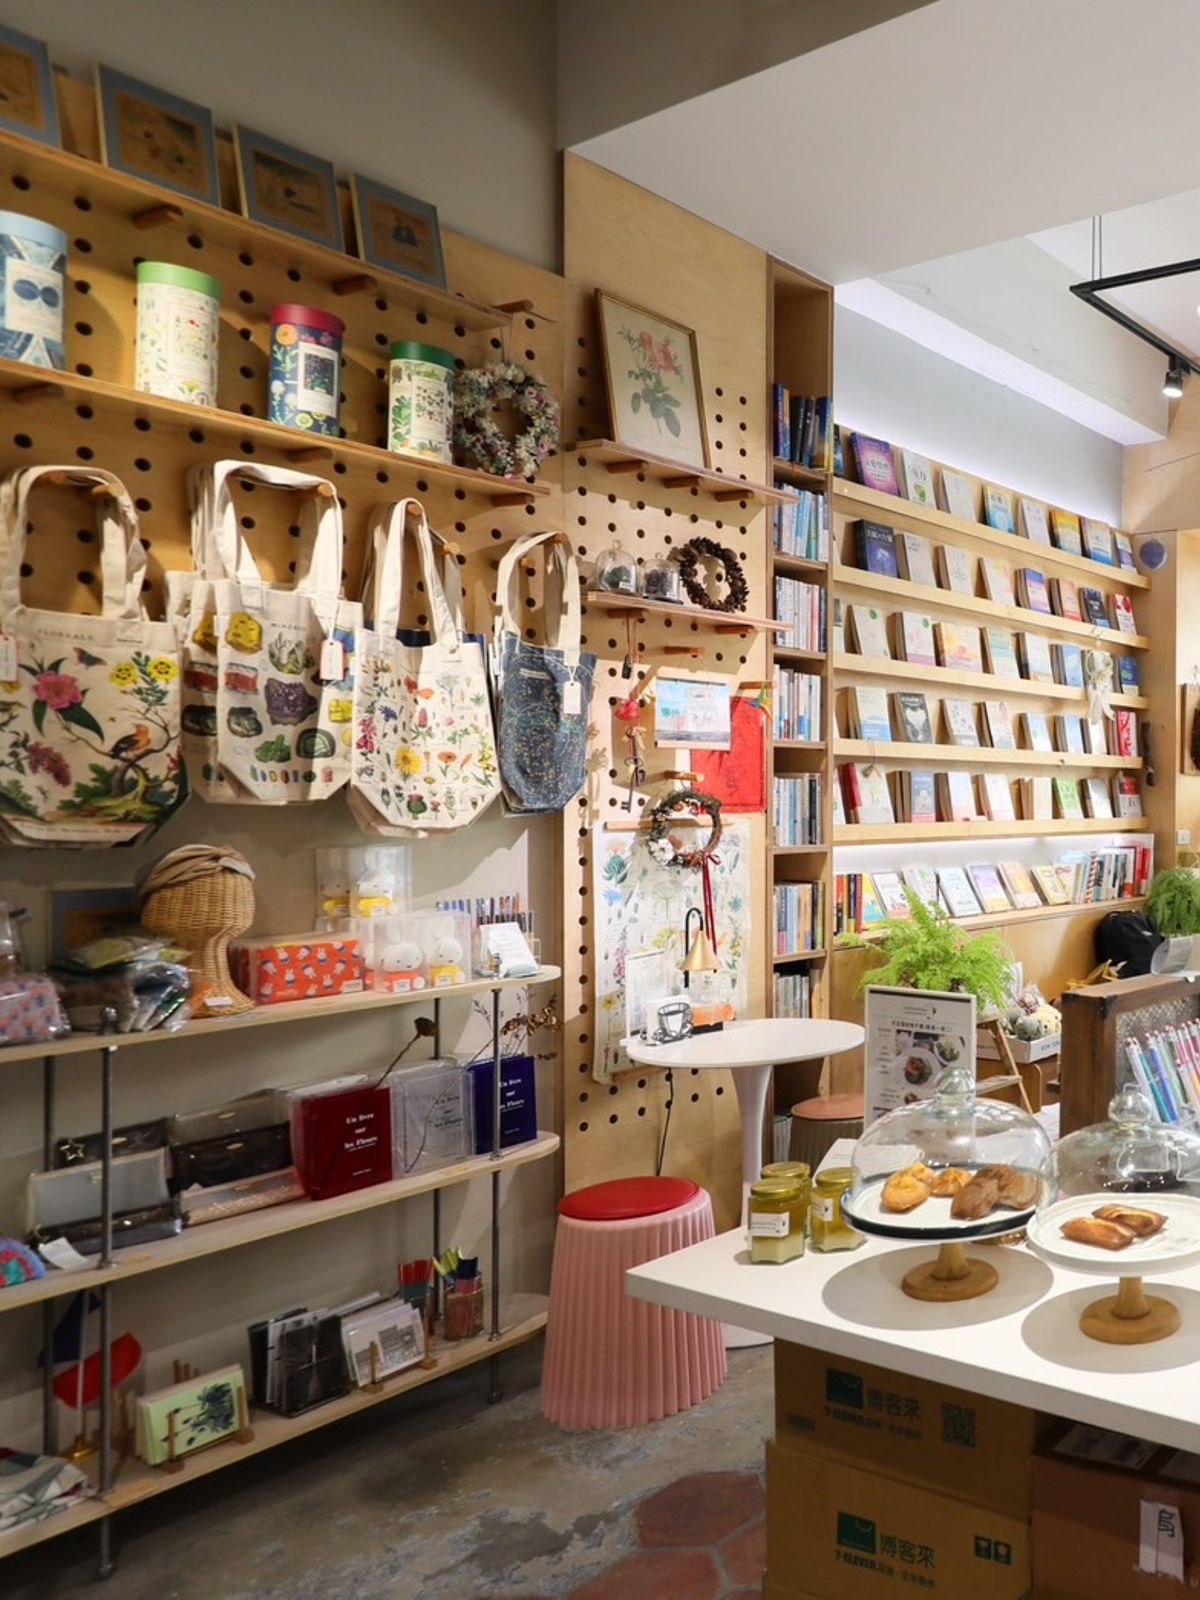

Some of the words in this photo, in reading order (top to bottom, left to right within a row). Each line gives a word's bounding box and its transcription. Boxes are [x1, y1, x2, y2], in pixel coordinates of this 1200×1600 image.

[346, 1115, 357, 1124] Un
[358, 1112, 375, 1122] livre
[355, 1126, 367, 1134] sur
[344, 1141, 355, 1150] les
[355, 1135, 378, 1147] Fleurs
[868, 1387, 921, 1420] 博客來
[880, 1532, 936, 1569] 博客來
